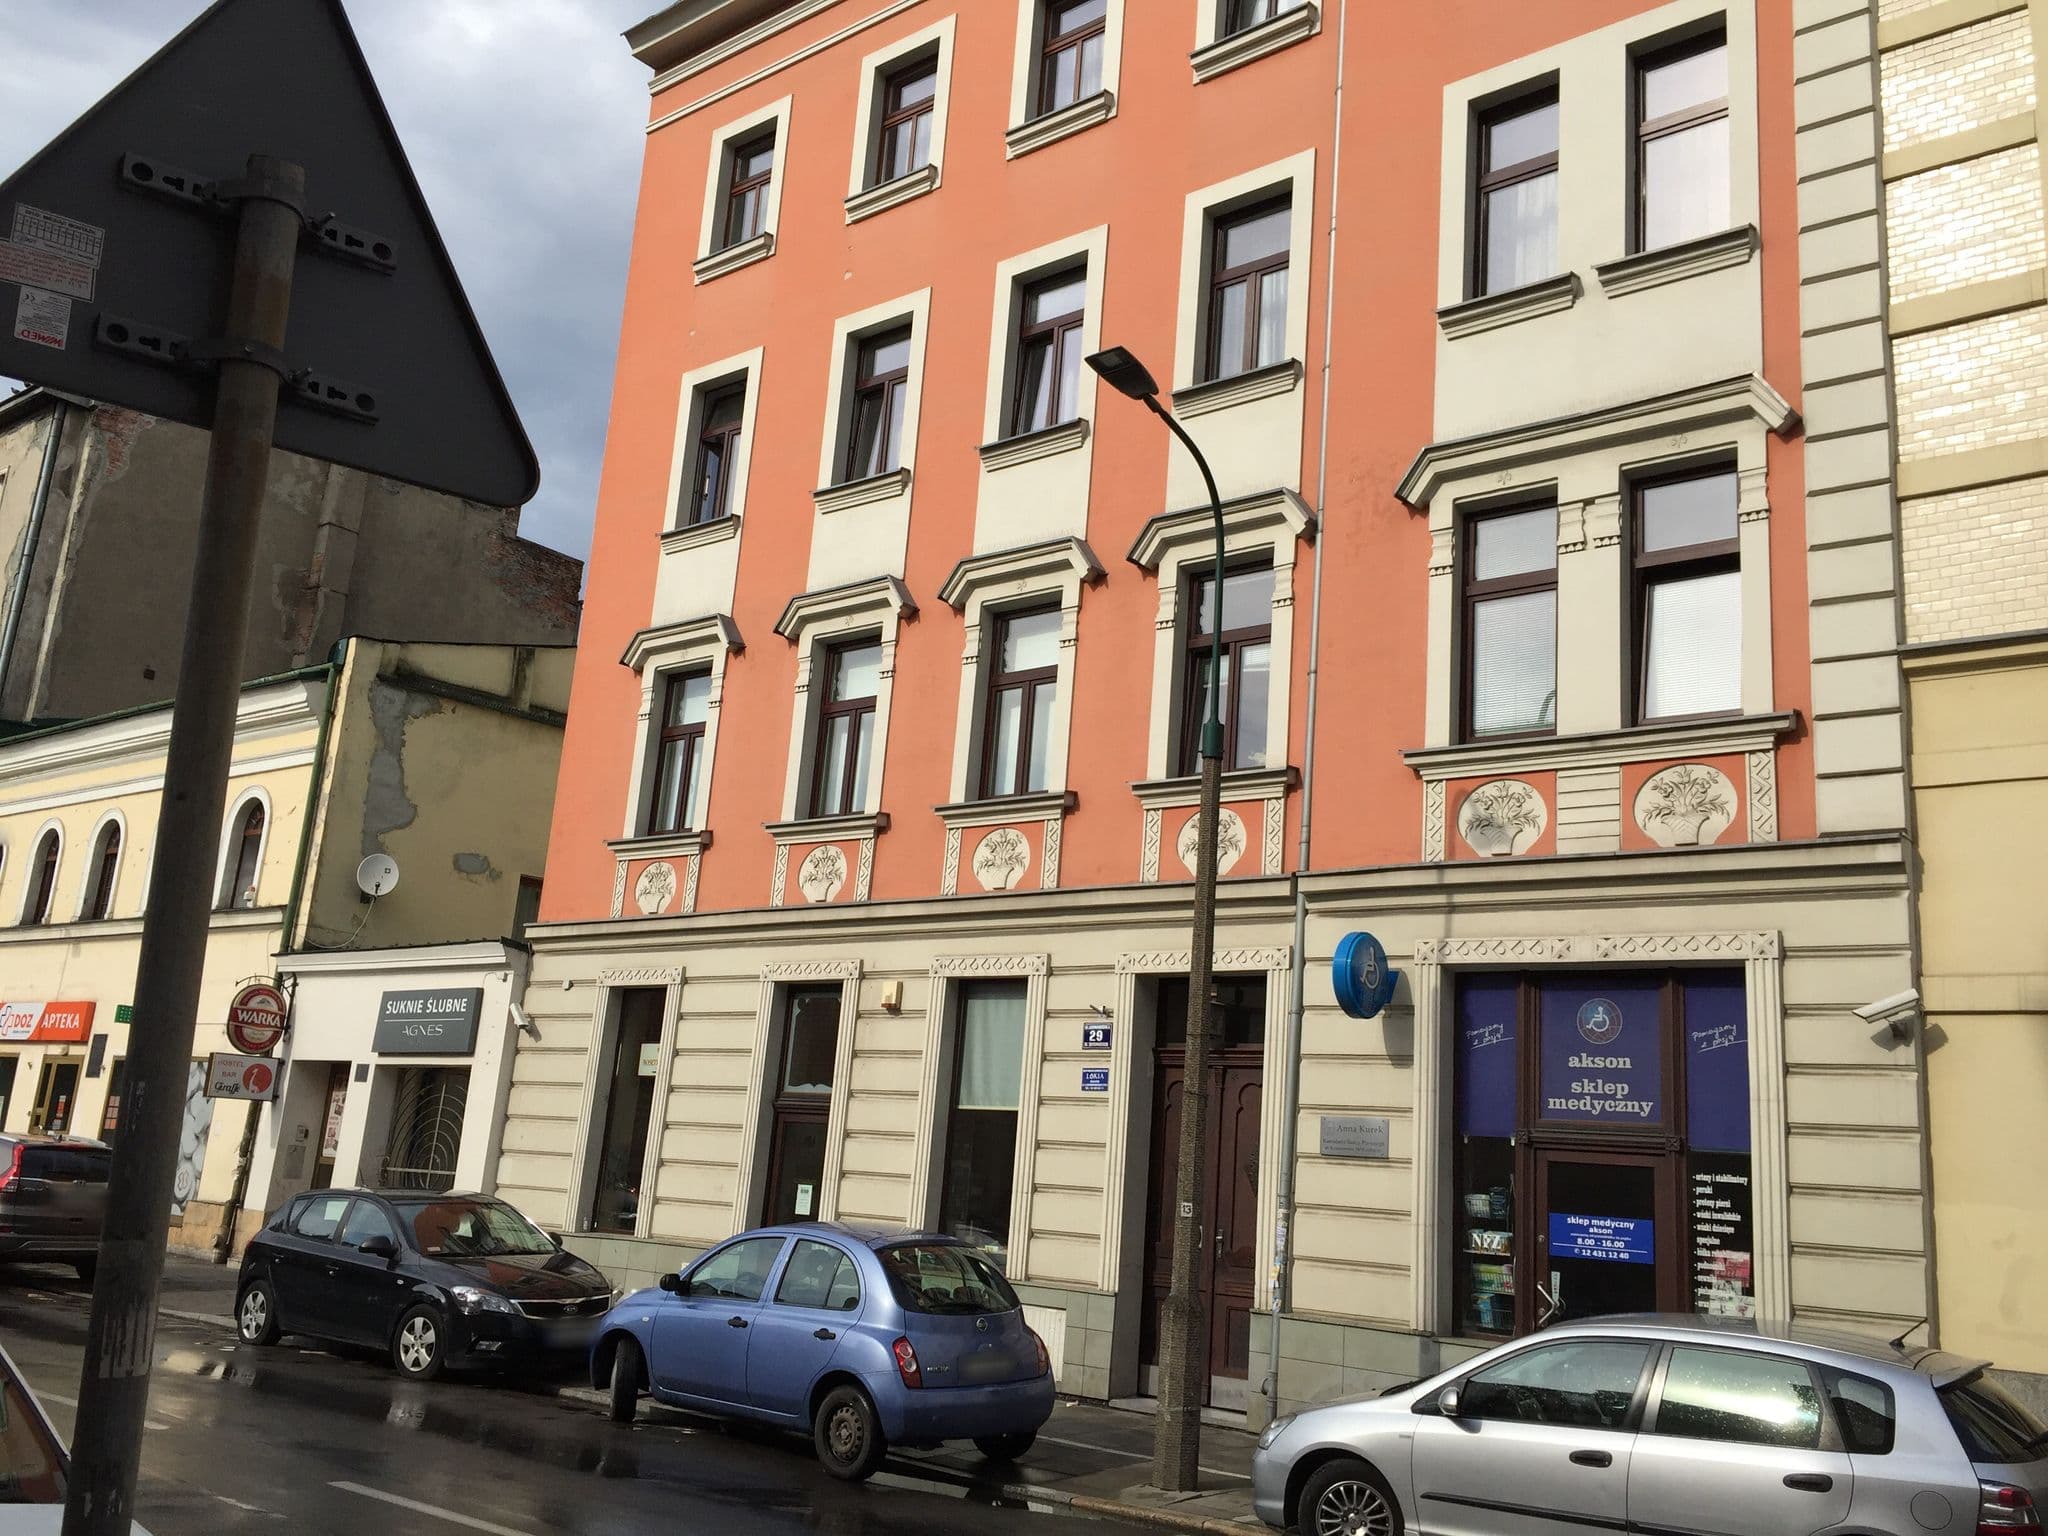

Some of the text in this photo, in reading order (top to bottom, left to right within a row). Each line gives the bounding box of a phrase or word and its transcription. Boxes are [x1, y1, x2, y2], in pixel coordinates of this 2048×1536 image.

[386, 996, 468, 1014] SUKNIE ŚLUBNE
[14, 1014, 34, 1028] DOZ
[41, 1013, 80, 1028] APTEKA
[236, 1009, 281, 1027] WARKA
[402, 1024, 443, 1036] AGNES
[1089, 1030, 1104, 1042] 29
[1568, 1053, 1632, 1069] akson
[1571, 1079, 1629, 1099] sklep
[1547, 1096, 1654, 1117] medyczny
[1337, 1125, 1384, 1134] Anna Kurek
[1567, 1216, 1635, 1230] sklep medyczny
[1588, 1227, 1613, 1235] akson
[1577, 1237, 1595, 1246] 8.00
[1601, 1239, 1625, 1249] 16.00
[1581, 1248, 1591, 1257] 12
[1608, 1251, 1618, 1259] 12
[1618, 1252, 1630, 1260] 40
